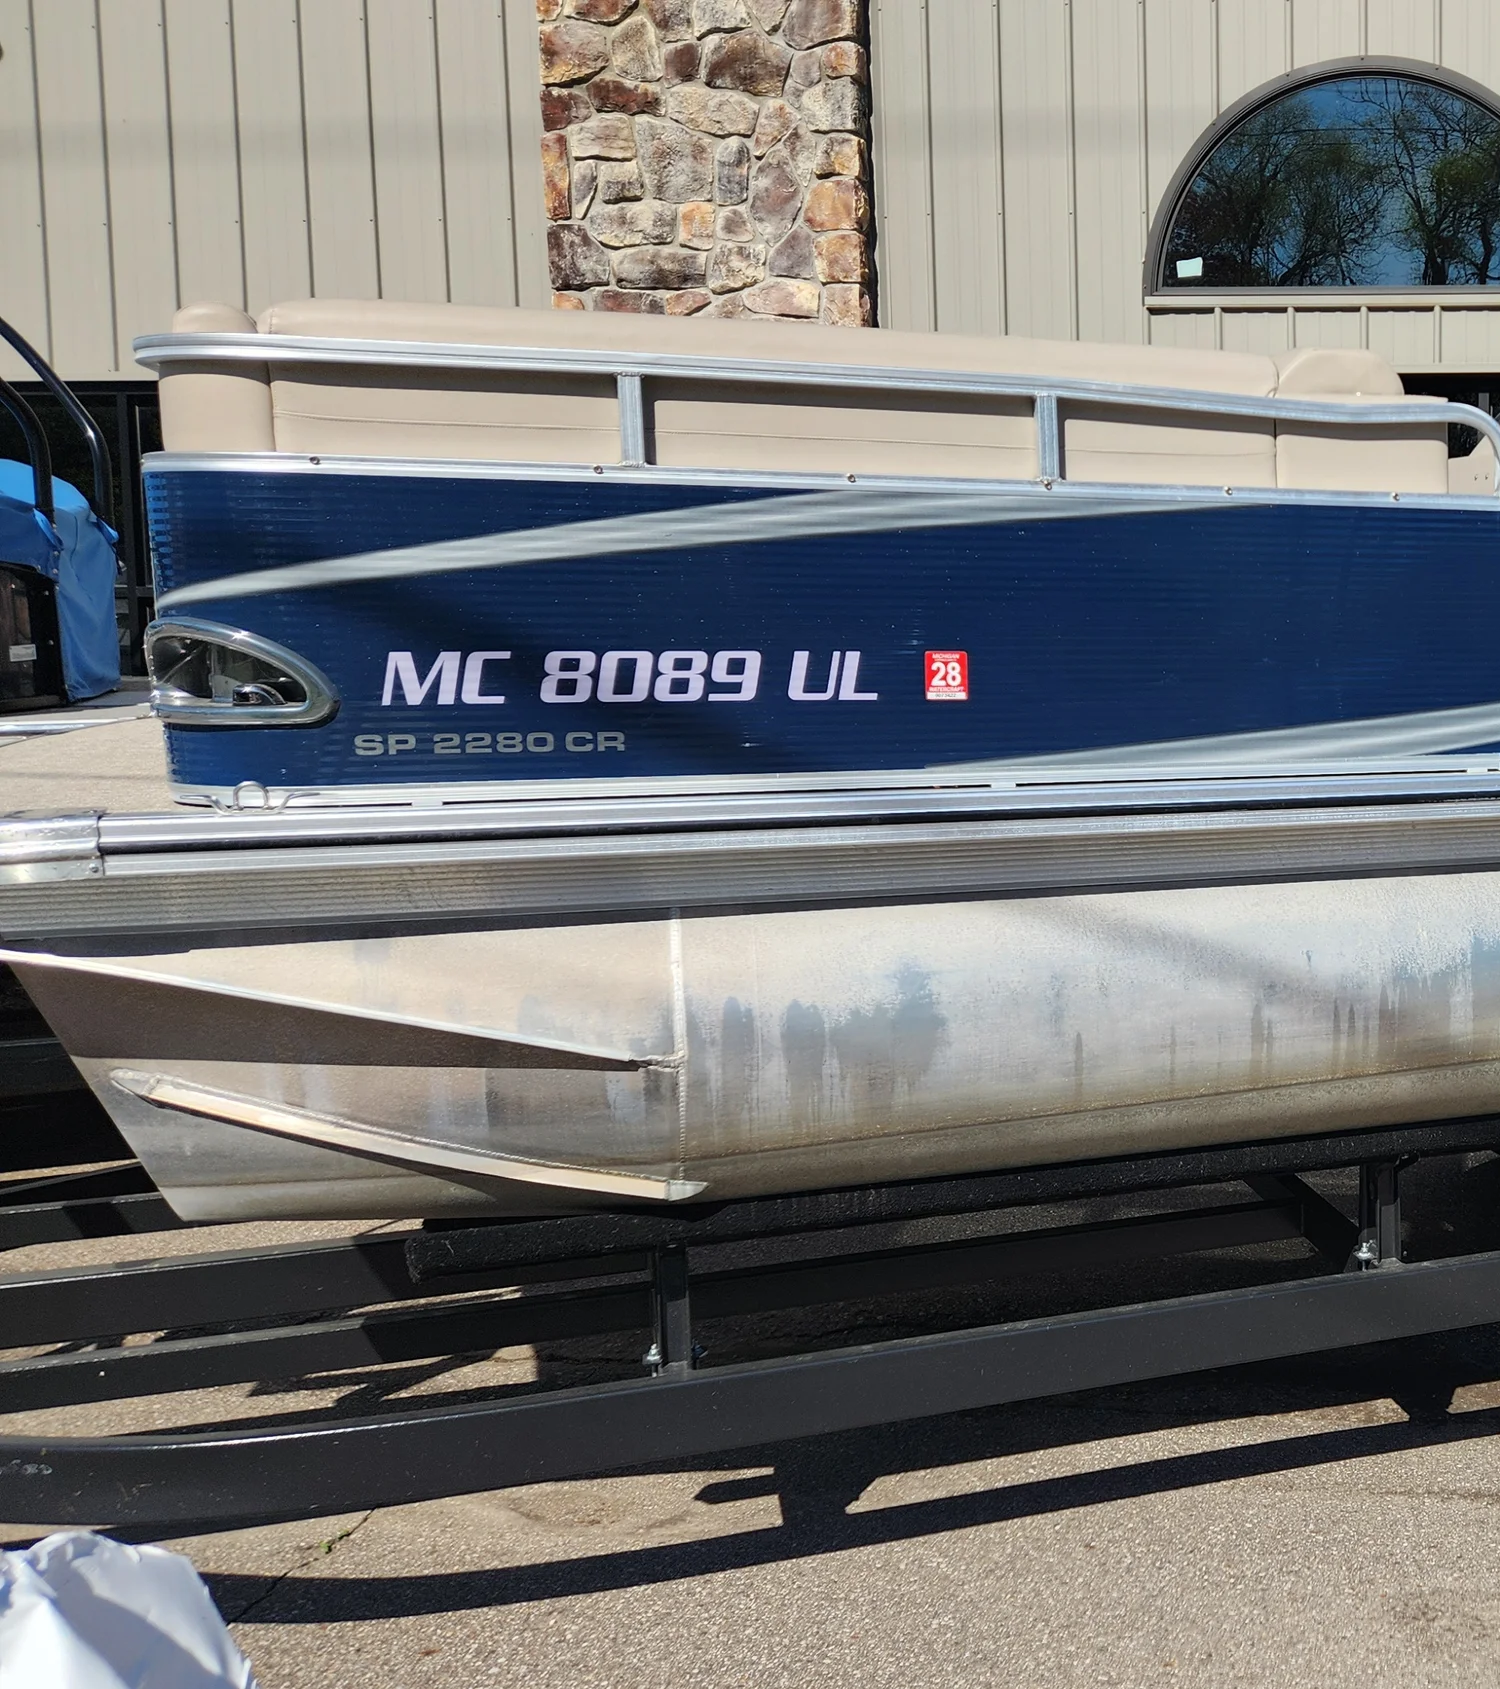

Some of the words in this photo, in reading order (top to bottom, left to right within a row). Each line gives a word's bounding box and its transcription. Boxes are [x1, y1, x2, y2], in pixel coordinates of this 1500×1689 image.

[381, 651, 512, 706] MC
[540, 650, 762, 703] 8089
[788, 650, 879, 701] UL
[930, 661, 962, 687] 28
[354, 734, 417, 756] SP
[433, 732, 555, 754] 2280
[565, 731, 626, 752] CR
